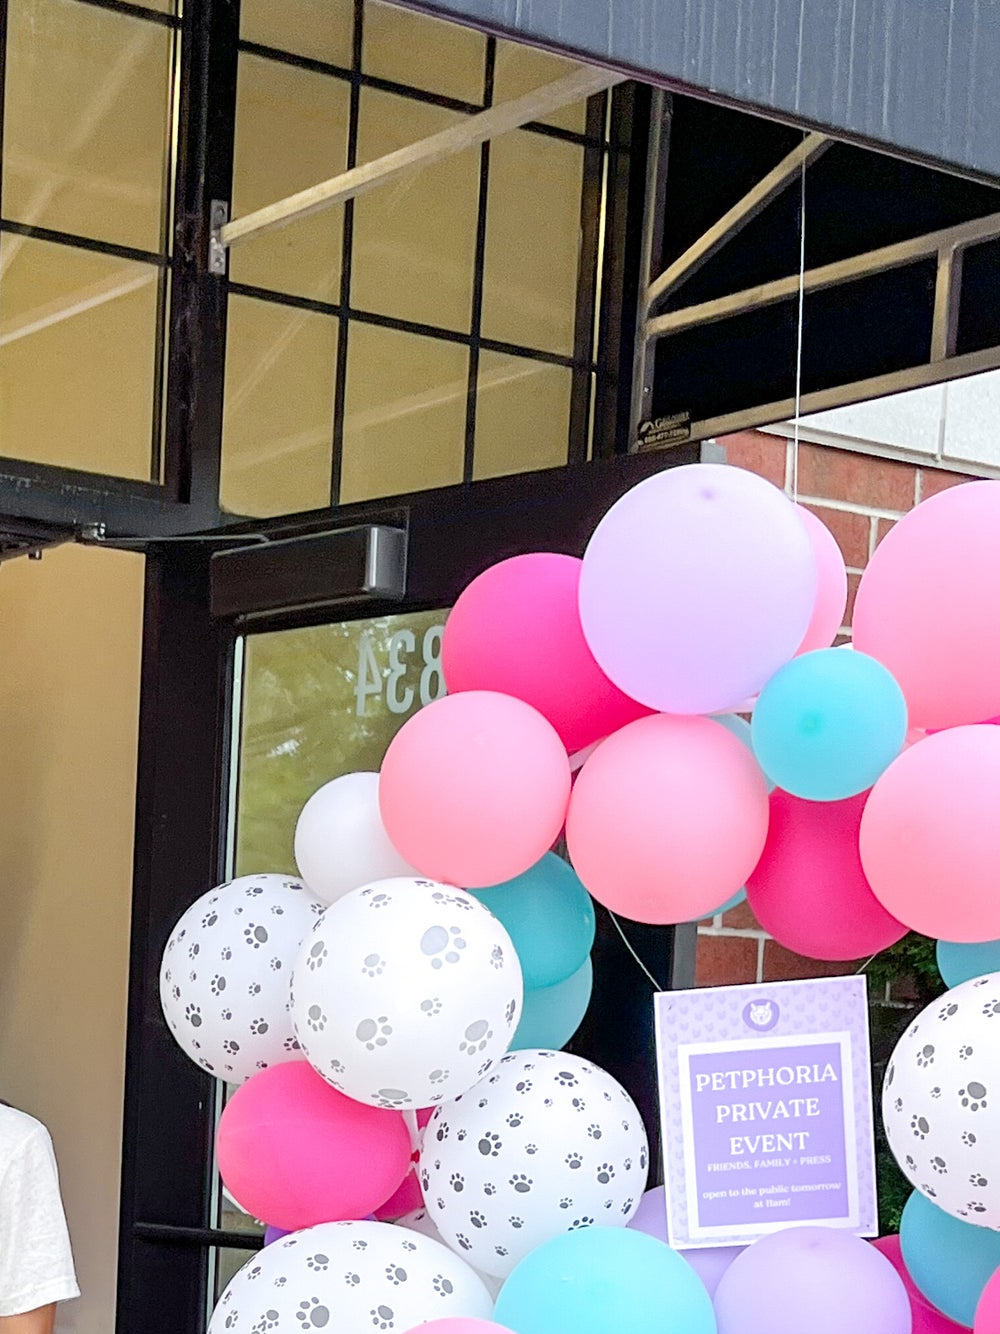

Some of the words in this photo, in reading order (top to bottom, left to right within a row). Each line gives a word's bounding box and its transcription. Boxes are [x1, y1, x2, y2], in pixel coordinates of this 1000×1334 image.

[695, 1063, 838, 1092] PETPHORIA
[716, 1098, 820, 1123] PRIVATE
[729, 1132, 810, 1155] EVENT
[754, 1158, 791, 1169] FAMILY
[800, 1155, 831, 1166] PRESS
[702, 1190, 727, 1201] open
[728, 1188, 740, 1198] to
[741, 1187, 757, 1197] the
[759, 1184, 789, 1197] public
[791, 1182, 842, 1193] tomorrow
[753, 1200, 764, 1209] at
